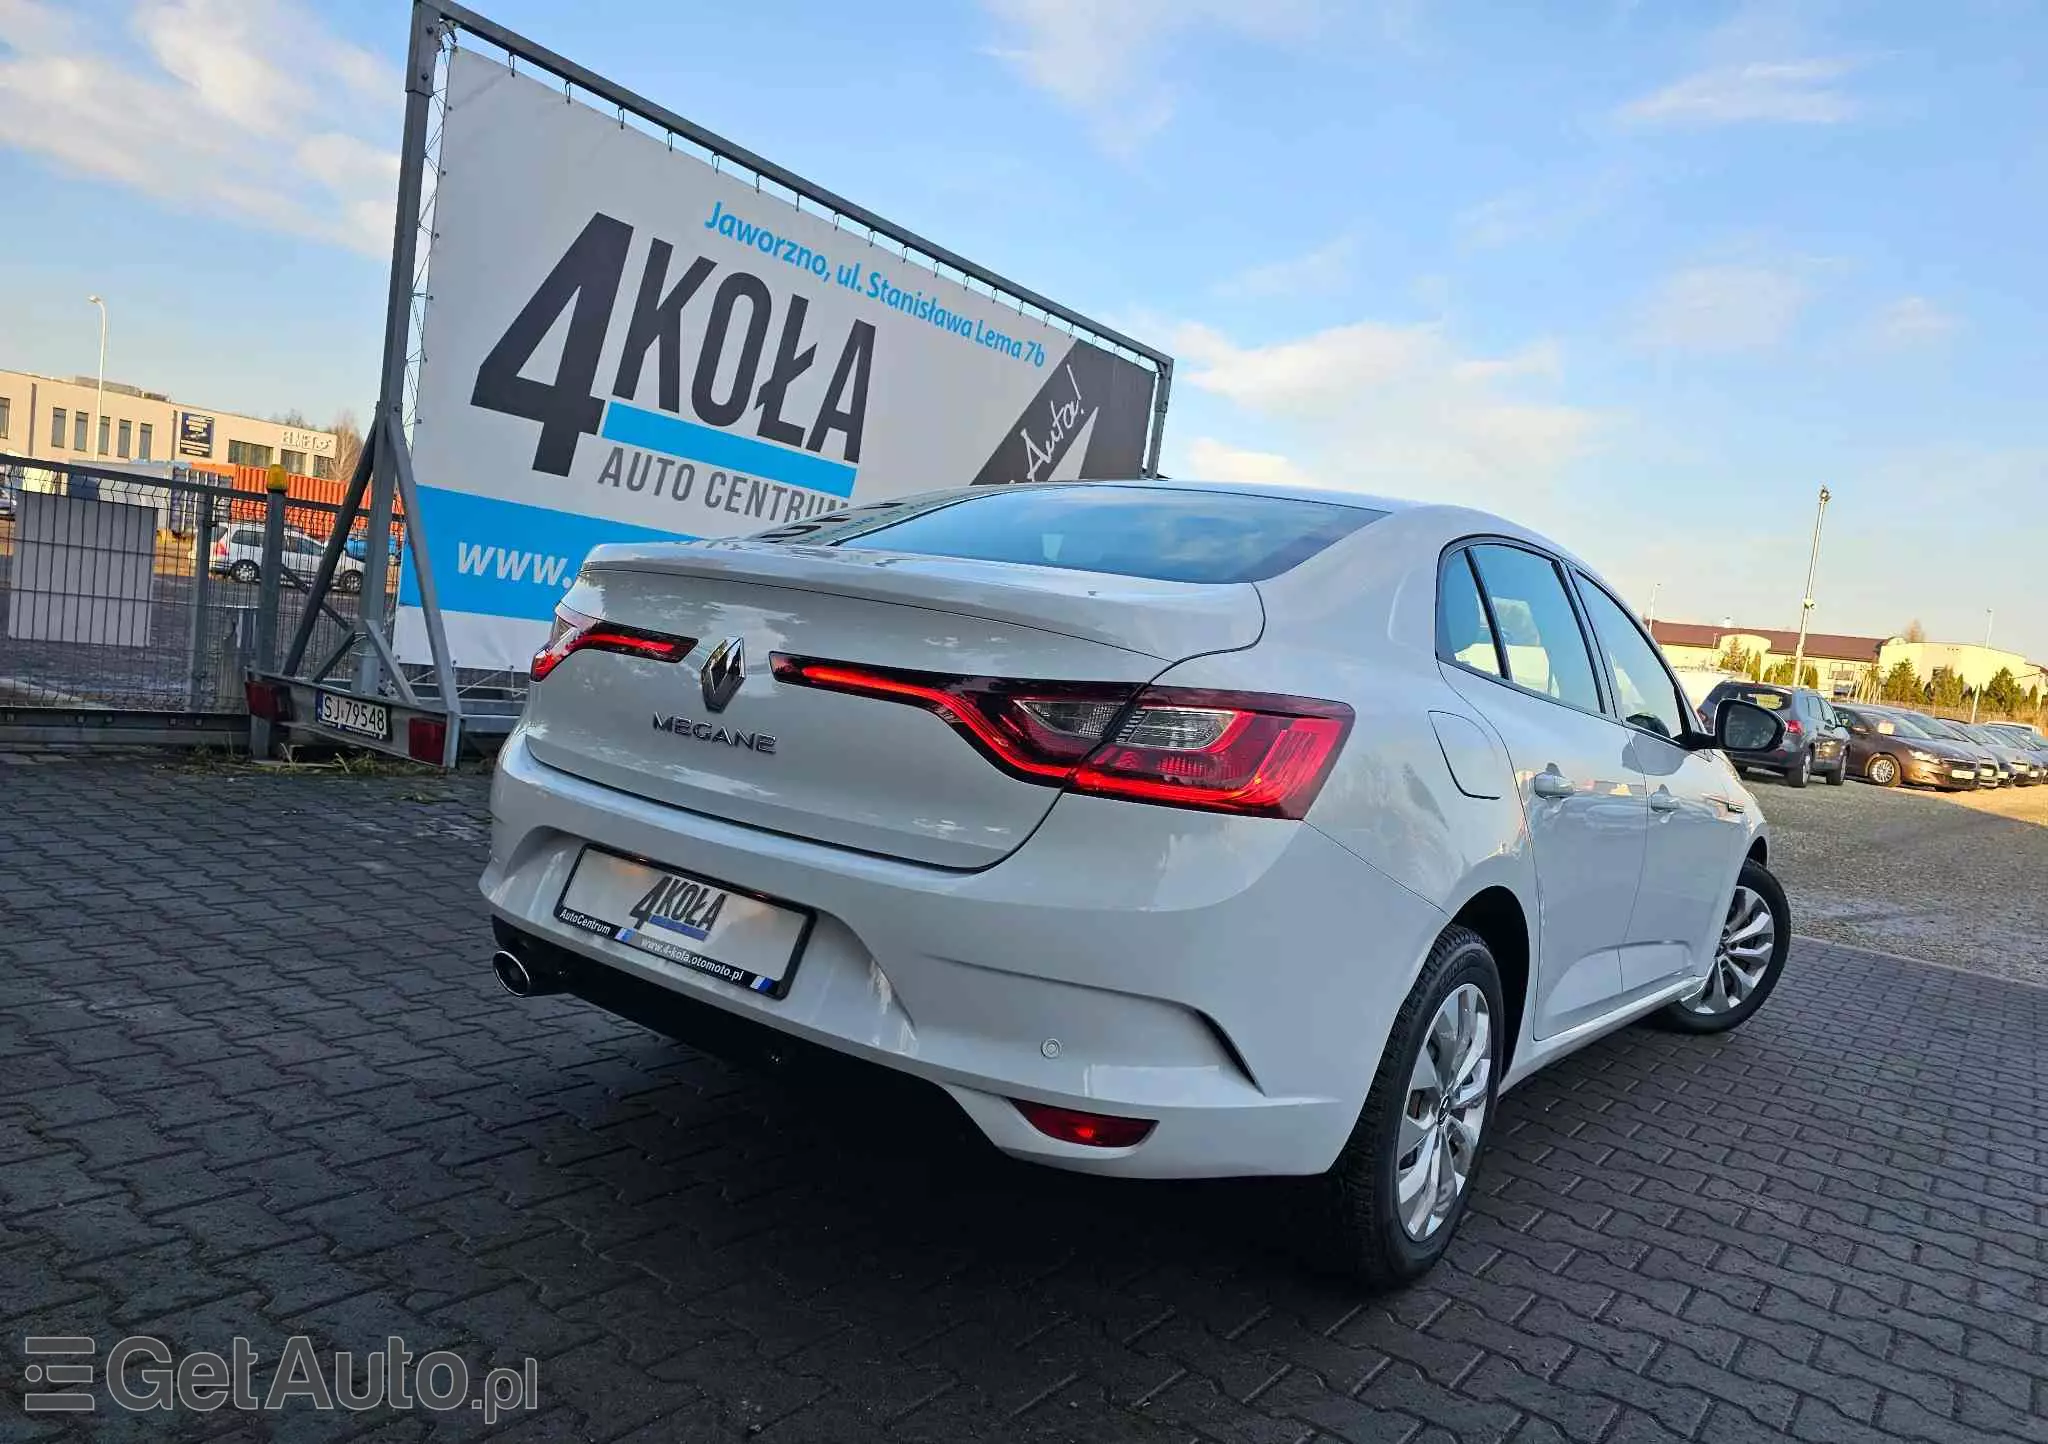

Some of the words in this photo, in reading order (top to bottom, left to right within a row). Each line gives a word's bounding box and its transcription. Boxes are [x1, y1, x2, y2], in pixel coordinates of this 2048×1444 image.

[704, 201, 831, 282] Jaworzno,
[837, 263, 862, 292] ul.
[866, 271, 973, 338] Stanisława
[975, 319, 1022, 359] Lema
[1024, 340, 1045, 367] 7b
[598, 446, 695, 501] AUTO
[457, 541, 573, 588] www.
[345, 701, 384, 731] 79548
[652, 711, 776, 754] MEGANE
[559, 908, 611, 935] AutoCentrum
